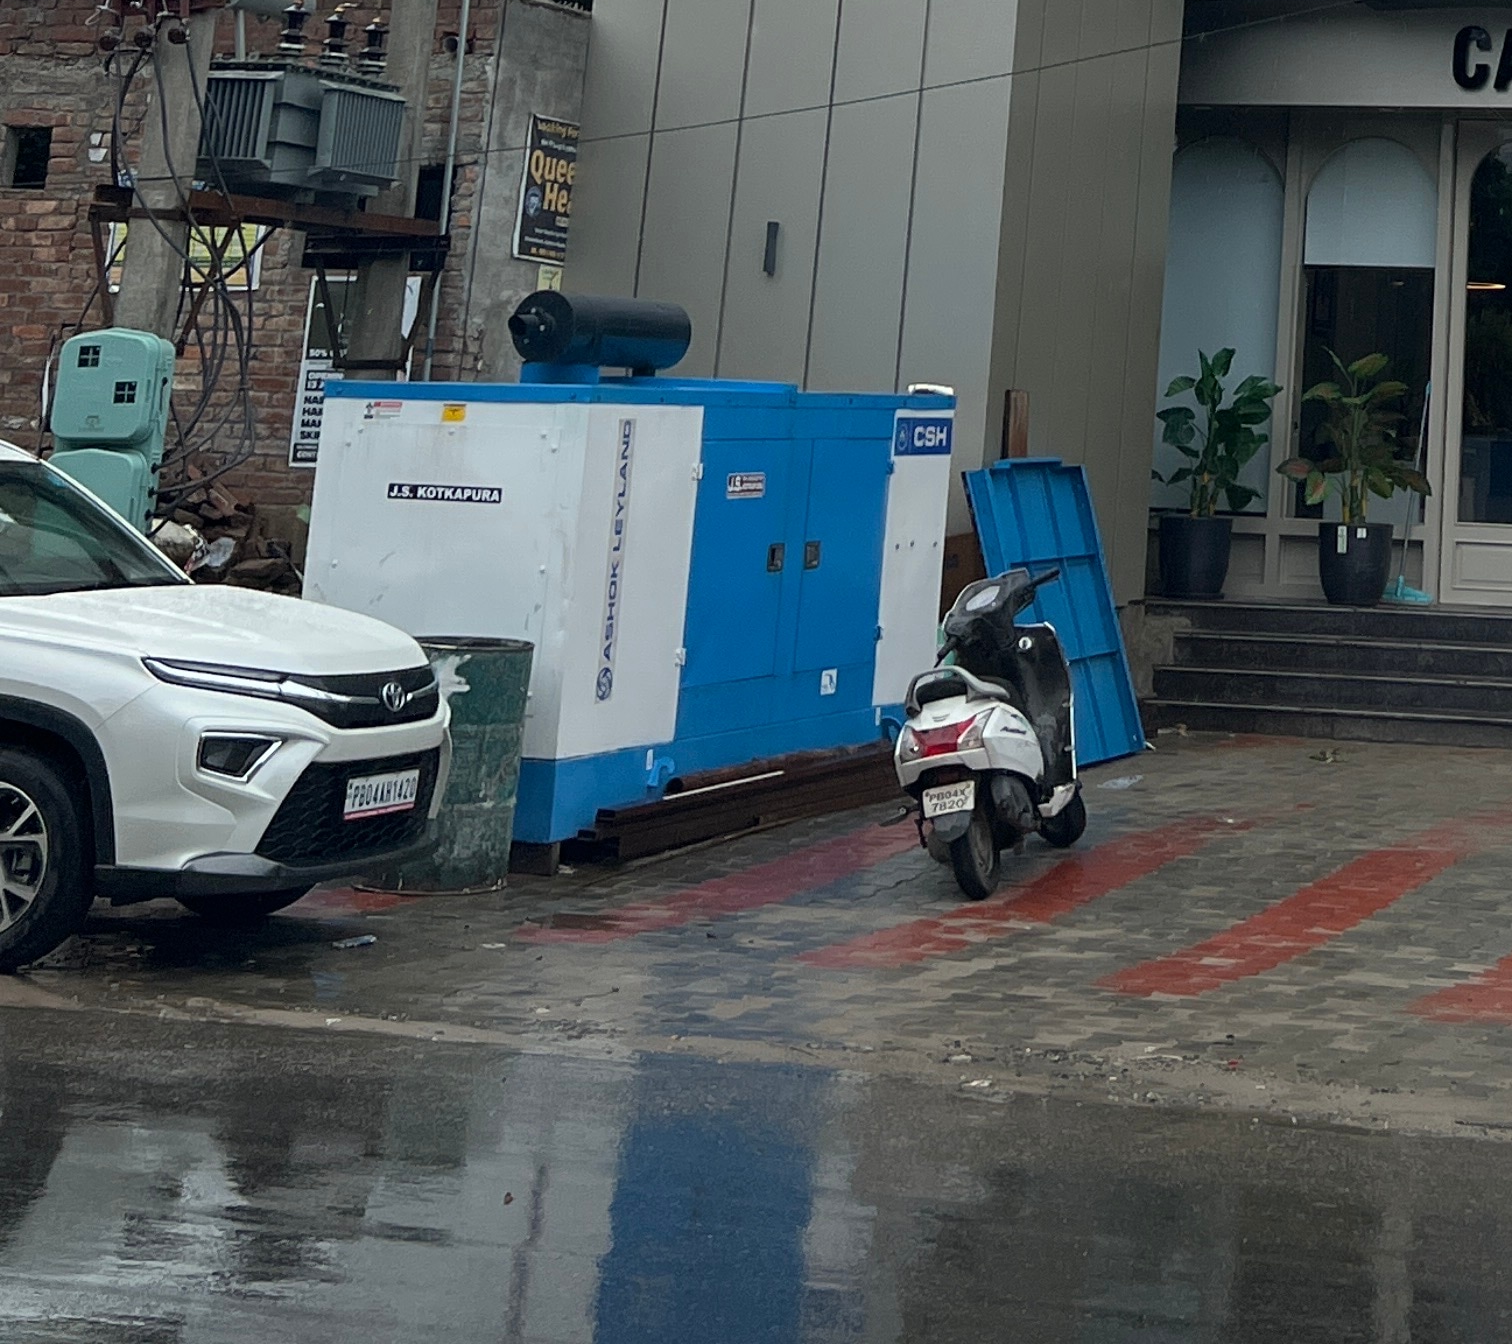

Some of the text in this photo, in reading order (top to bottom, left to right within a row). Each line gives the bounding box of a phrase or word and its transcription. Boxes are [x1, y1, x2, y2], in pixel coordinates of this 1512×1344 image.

[913, 425, 948, 448] CSH
[389, 485, 500, 502] J.S. KOTKAPURA
[602, 419, 632, 662] ASHOK LEYLAND
